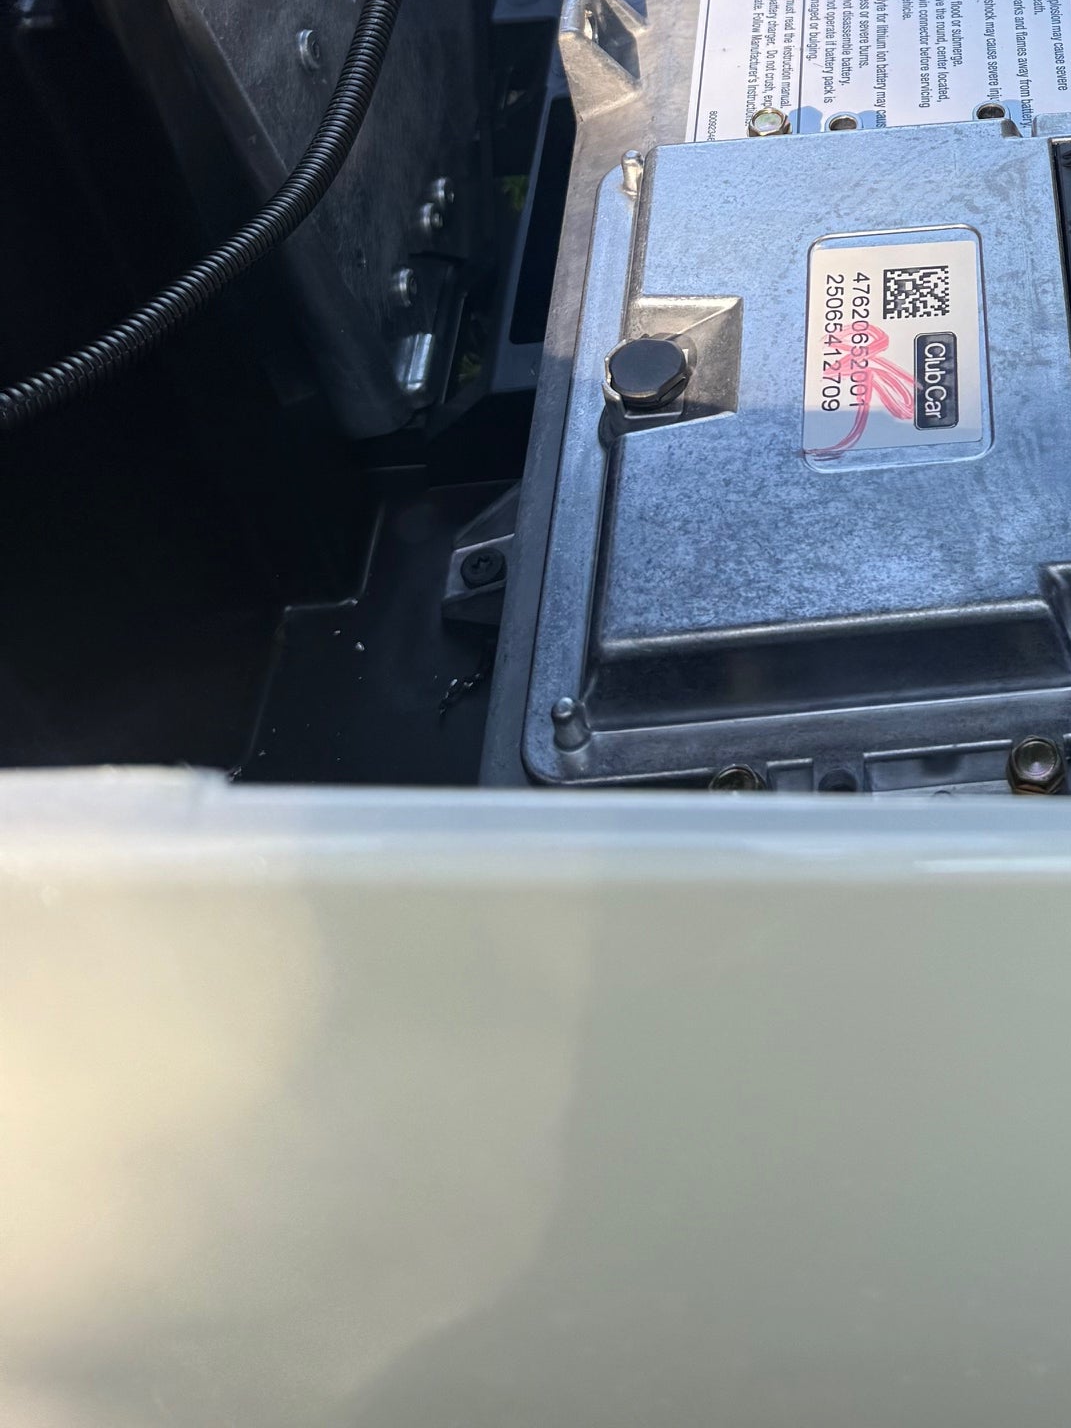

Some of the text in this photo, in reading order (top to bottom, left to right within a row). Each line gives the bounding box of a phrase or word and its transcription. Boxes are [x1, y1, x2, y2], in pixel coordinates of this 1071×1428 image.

[877, 13, 888, 22] for
[936, 8, 947, 19] the
[951, 0, 963, 18] flood
[984, 0, 997, 20] shock
[752, 12, 764, 32] Follow
[765, 20, 779, 45] charger.
[785, 16, 795, 30] read
[825, 11, 837, 38] operate
[842, 10, 854, 55] disassemble
[860, 20, 869, 43] severe
[919, 9, 930, 45] connector
[935, 21, 948, 44] round,
[952, 19, 961, 27] or
[984, 21, 995, 36] may
[1015, 16, 1027, 29] and
[1051, 25, 1062, 40] may
[784, 32, 795, 43] the
[806, 31, 821, 61] bulging.
[877, 24, 888, 49] lithium
[951, 29, 963, 66] submerge.
[1016, 31, 1028, 56] flames
[749, 34, 762, 83] Manufacturer's
[767, 49, 777, 58] Do
[822, 47, 836, 73] battery
[859, 45, 871, 68] burns.
[877, 50, 888, 62] ion
[920, 47, 931, 70] before
[937, 46, 948, 69] center
[987, 38, 997, 59] cause
[1054, 42, 1065, 64] cause
[766, 60, 776, 71] not
[782, 45, 794, 80] instruction
[839, 57, 853, 85] battery.
[988, 61, 999, 85] severe
[1017, 57, 1029, 77] away
[763, 72, 775, 93] crush,
[822, 76, 836, 94] pack
[874, 63, 888, 89] battery
[937, 71, 949, 102] located,
[1056, 65, 1068, 90] severe
[781, 81, 791, 108] manual.
[874, 91, 886, 107] may
[919, 72, 932, 107] servicing
[1020, 79, 1031, 97] from
[876, 109, 887, 127] caus
[1019, 98, 1035, 128] battery.
[821, 274, 845, 412] 25065412709
[849, 271, 870, 407] 47620652001
[924, 342, 947, 418] Club Car
